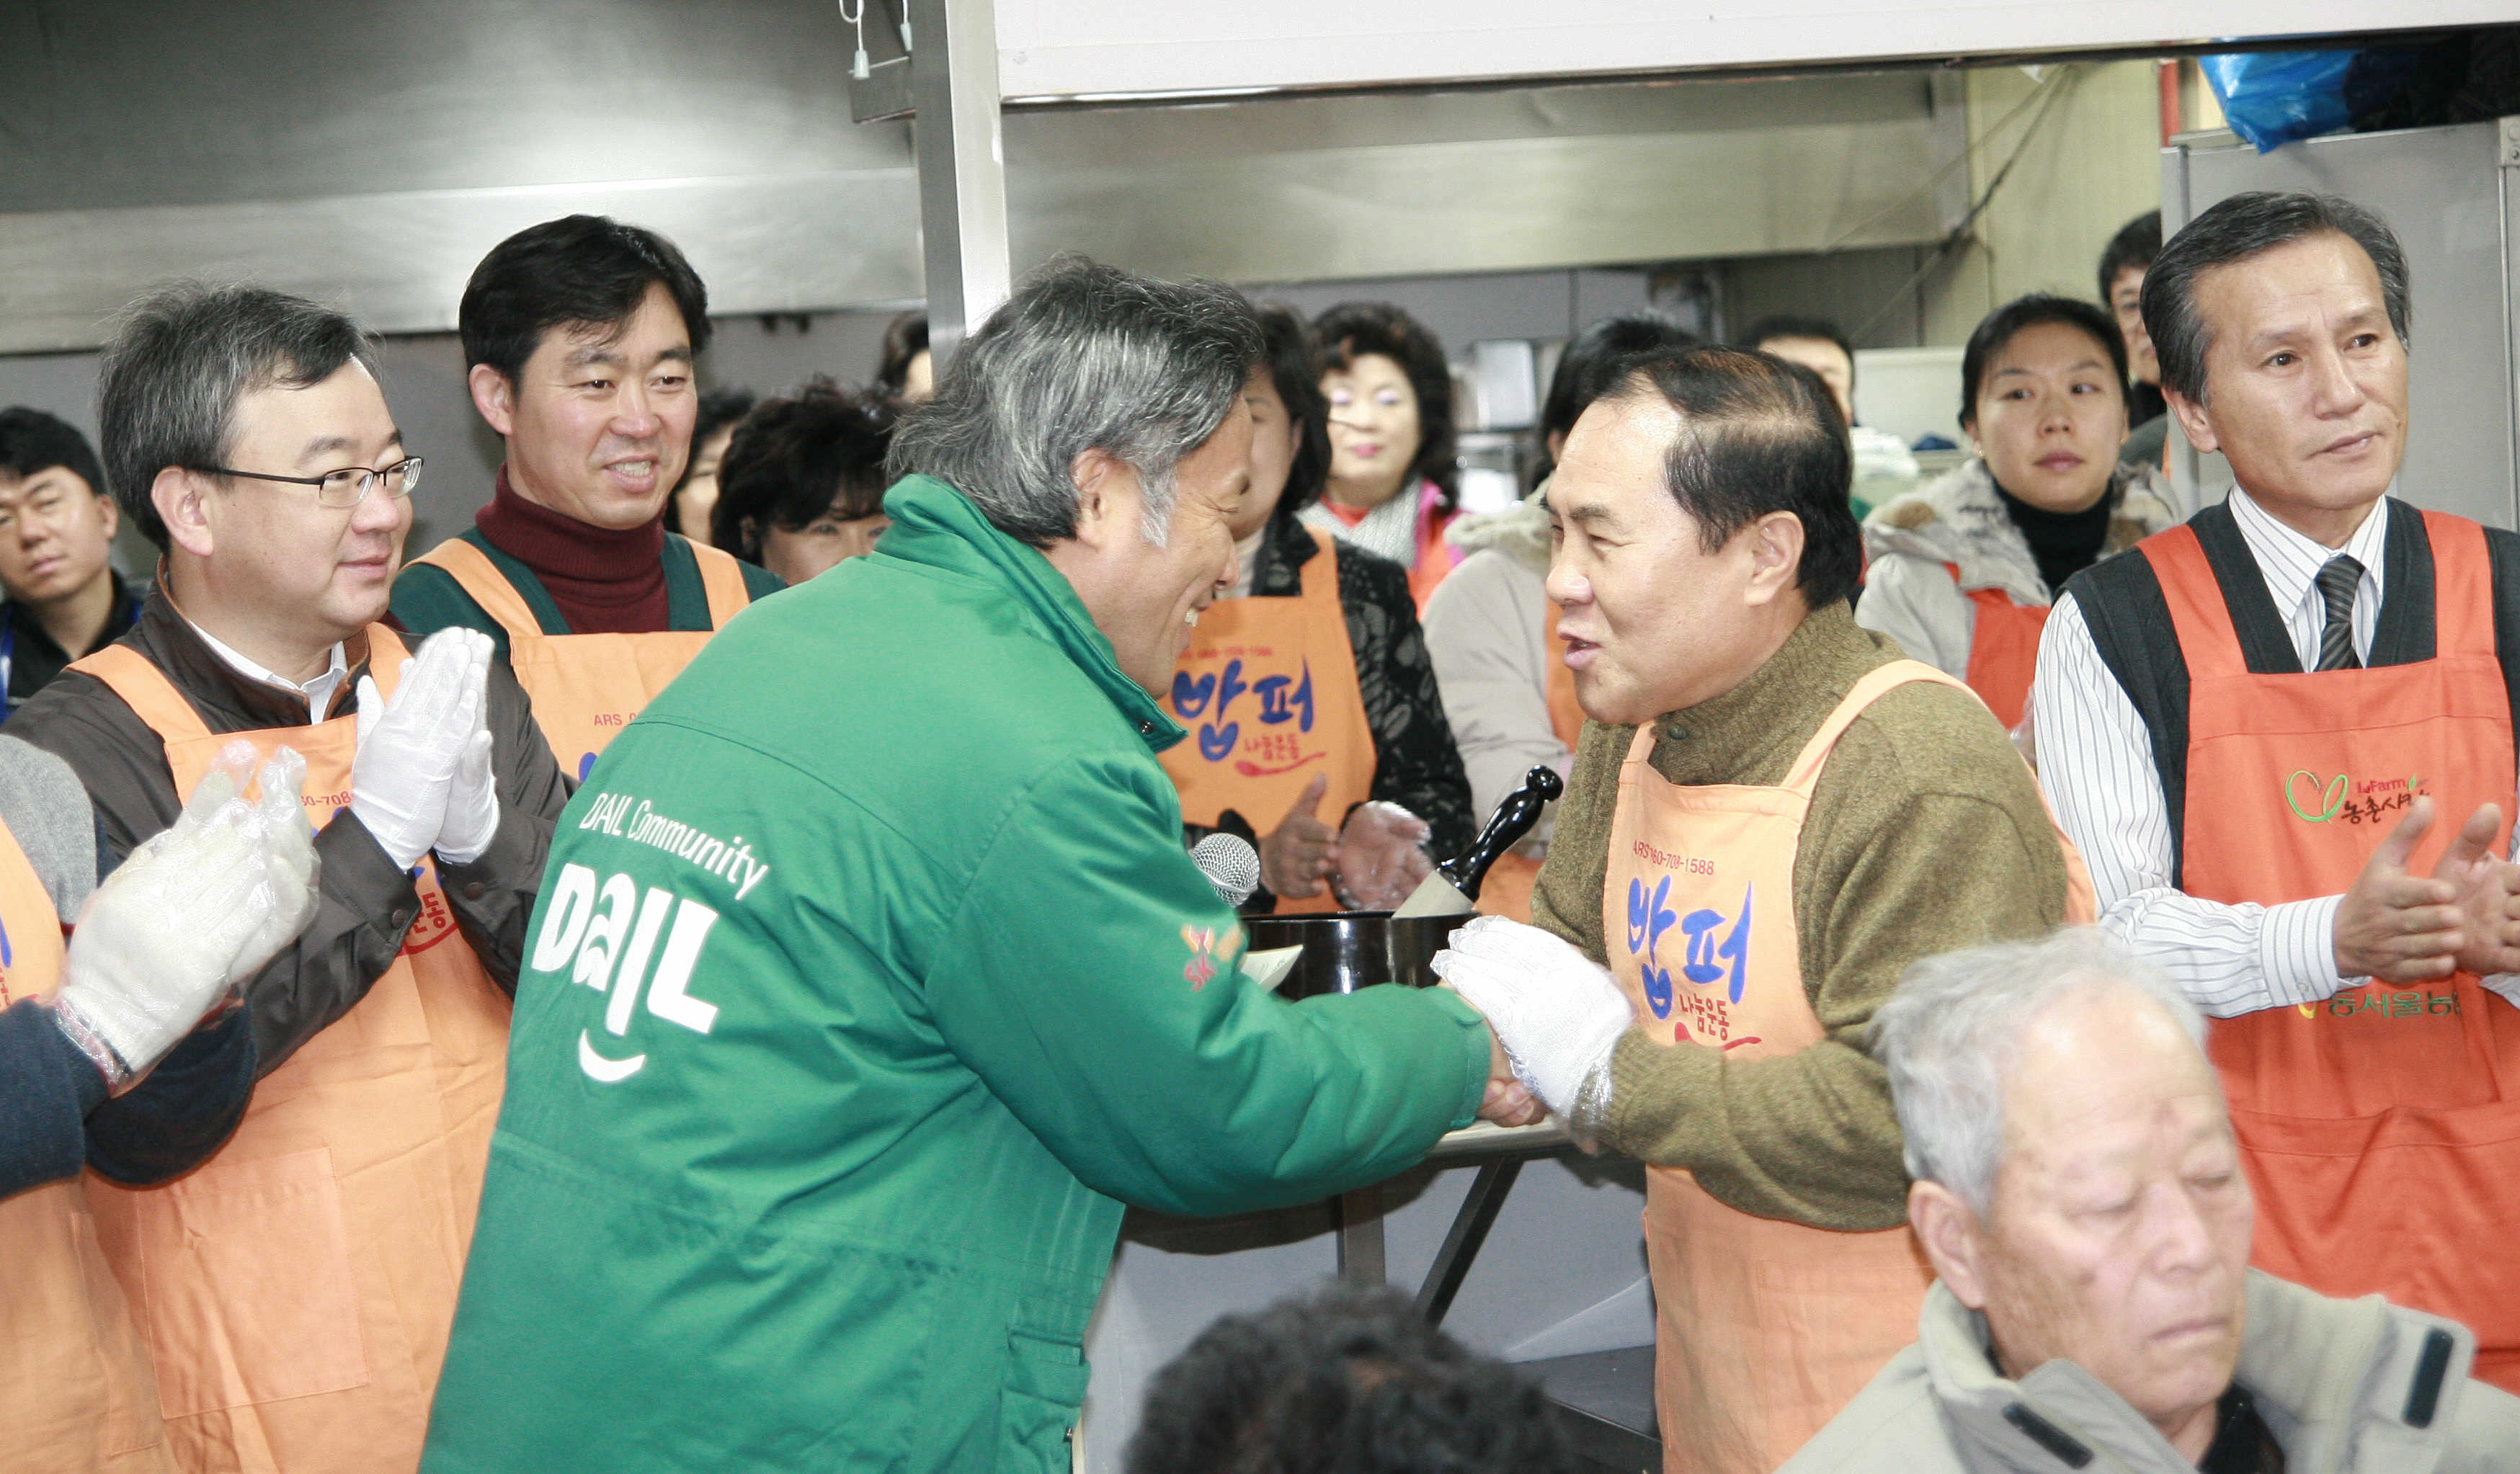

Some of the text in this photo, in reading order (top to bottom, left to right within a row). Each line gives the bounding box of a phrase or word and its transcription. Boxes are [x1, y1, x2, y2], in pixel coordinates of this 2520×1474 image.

[594, 714, 623, 726] ARS
[579, 793, 769, 901] DAIL Community
[1628, 874, 1753, 1019] 밥퍼
[1185, 955, 1216, 991] SK
[1680, 993, 1729, 1040] 나눔운동
